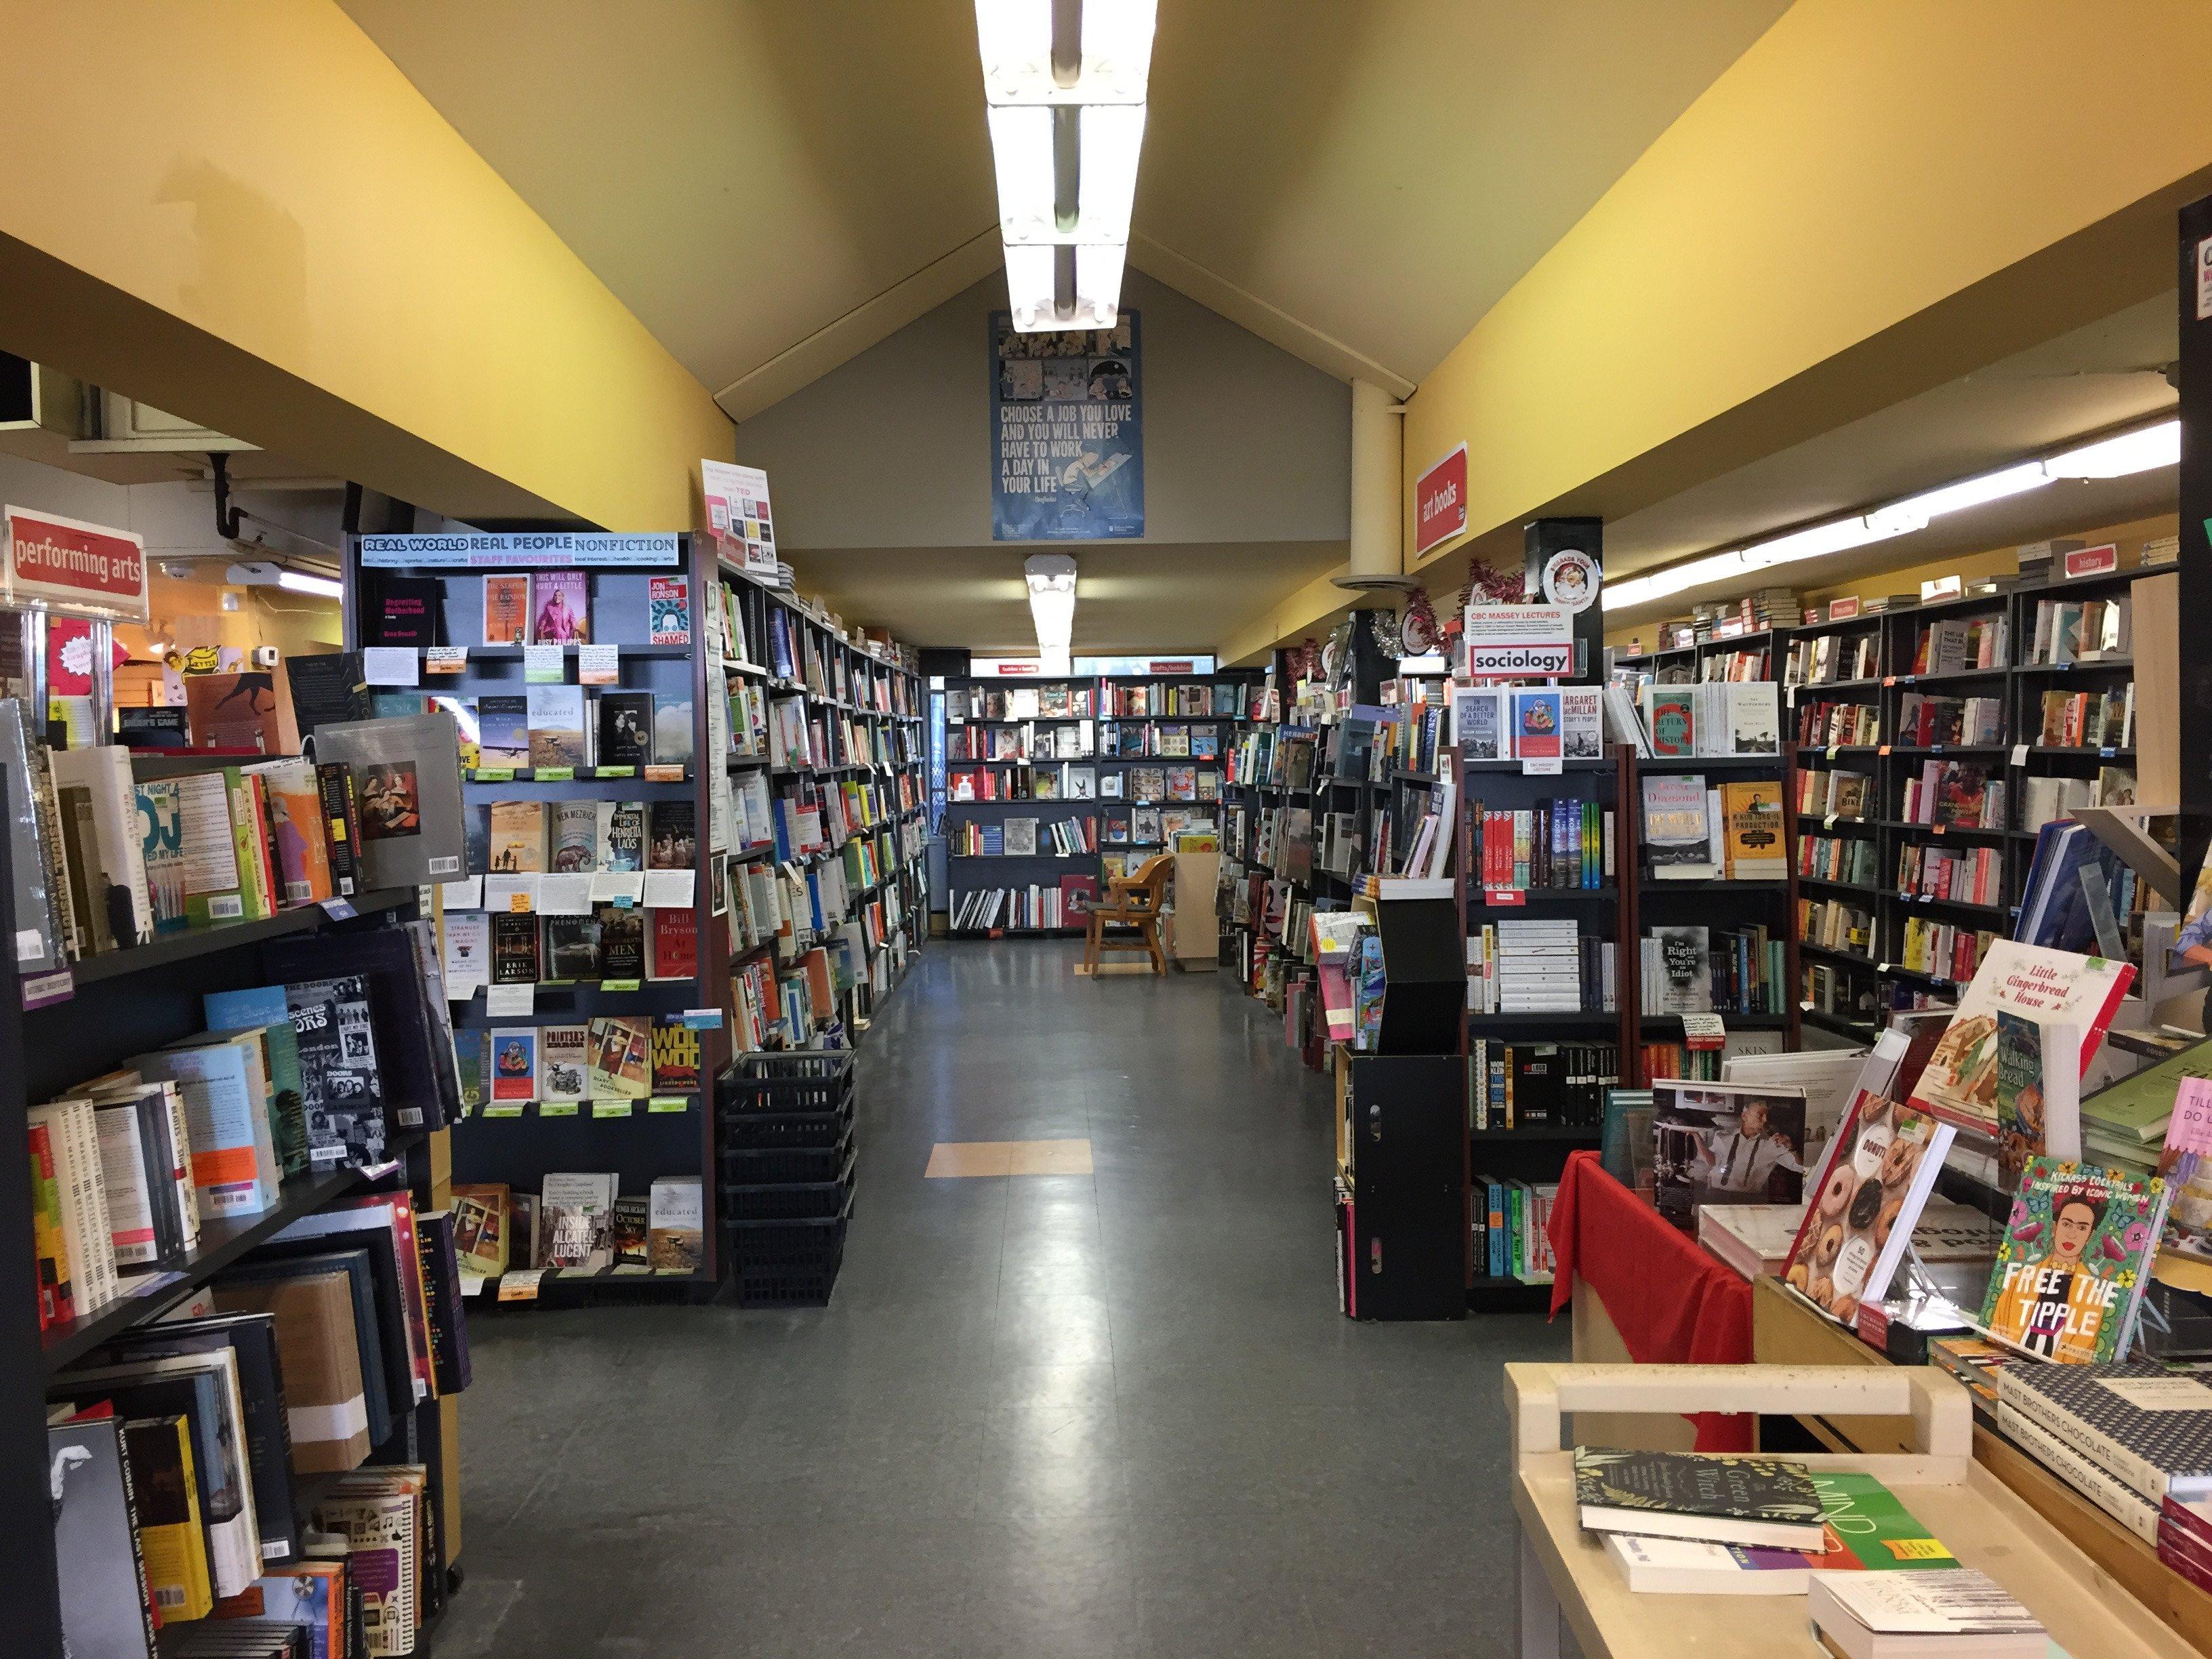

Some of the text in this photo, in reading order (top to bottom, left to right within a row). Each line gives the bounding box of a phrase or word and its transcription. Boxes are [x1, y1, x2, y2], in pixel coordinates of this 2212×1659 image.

[1001, 405, 1131, 423] CHOOSE A JOB YOU LOVE
[1001, 423, 1118, 441] AND YOU WILL NEVER
[1002, 441, 1082, 458] HAVE TO WORK
[1002, 459, 1049, 476] A DAY IN
[1002, 476, 1057, 493] YOUR LIFE
[1423, 480, 1456, 523] art books
[363, 536, 674, 551] REAL WORLD REAL PEOPLE NONFICTION
[16, 537, 140, 583] performing arts
[470, 554, 572, 564] STAFF FAVOURITES
[651, 589, 678, 598] RONSON
[653, 634, 688, 644] SHAMED
[1476, 650, 1568, 671] sociology
[532, 708, 573, 716] educated
[669, 914, 689, 924] Bill
[661, 925, 697, 935] Bryson
[609, 944, 636, 956] MEN
[1668, 947, 1696, 956] Right
[2028, 965, 2058, 980] Little
[2007, 975, 2070, 998] Gingerbread
[2013, 991, 2045, 1008] House
[288, 1004, 326, 1019] scenes
[300, 1044, 339, 1052] ondon
[1739, 1046, 1767, 1055] SKIN
[2001, 1047, 2034, 1076] Walking
[1999, 1067, 2024, 1088] Bread
[2184, 1110, 2202, 1122] DO
[2072, 1185, 2084, 1195] BY
[2087, 1187, 2112, 1198] ICONIC
[655, 1208, 697, 1216] educated
[559, 1216, 590, 1229] INSIDE
[553, 1230, 596, 1244] ALCATEL-
[554, 1244, 591, 1258] LUCENT
[2003, 1263, 2122, 1309] FREE THE
[2019, 1299, 2100, 1336] TIPPLE
[2003, 1382, 2111, 1461] MAST BROTHERS CHOCOLATE
[2020, 1428, 2055, 1462] BROTHERS
[2054, 1454, 2102, 1496] CHOCOLATE
[1696, 1469, 1725, 1500] Witch
[1727, 1469, 1750, 1504] Green
[119, 1428, 127, 1456] KURT
[123, 1460, 134, 1501] COBAIN
[134, 1529, 142, 1557] LAST
[139, 1560, 149, 1607] SESSION
